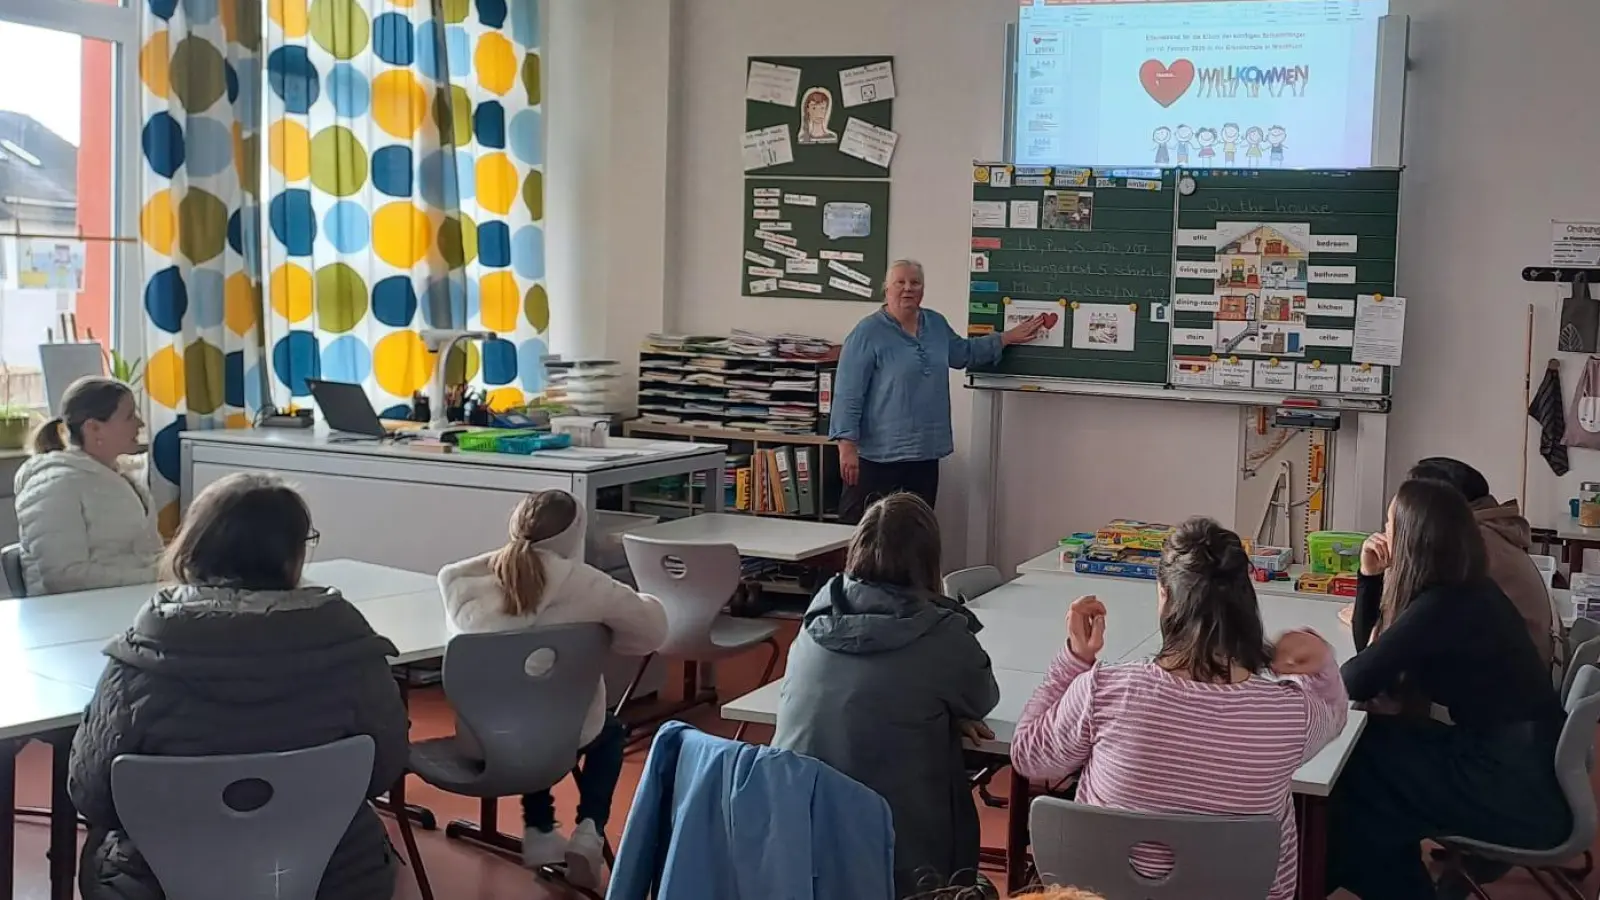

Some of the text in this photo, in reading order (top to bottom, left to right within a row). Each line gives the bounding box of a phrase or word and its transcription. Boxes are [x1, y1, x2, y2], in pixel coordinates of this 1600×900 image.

[1197, 65, 1309, 88] WILLKOMMEN
[1275, 197, 1329, 214] house
[1316, 239, 1349, 247] bedroom
[1180, 266, 1199, 275] living
[1317, 302, 1343, 311] kitchen
